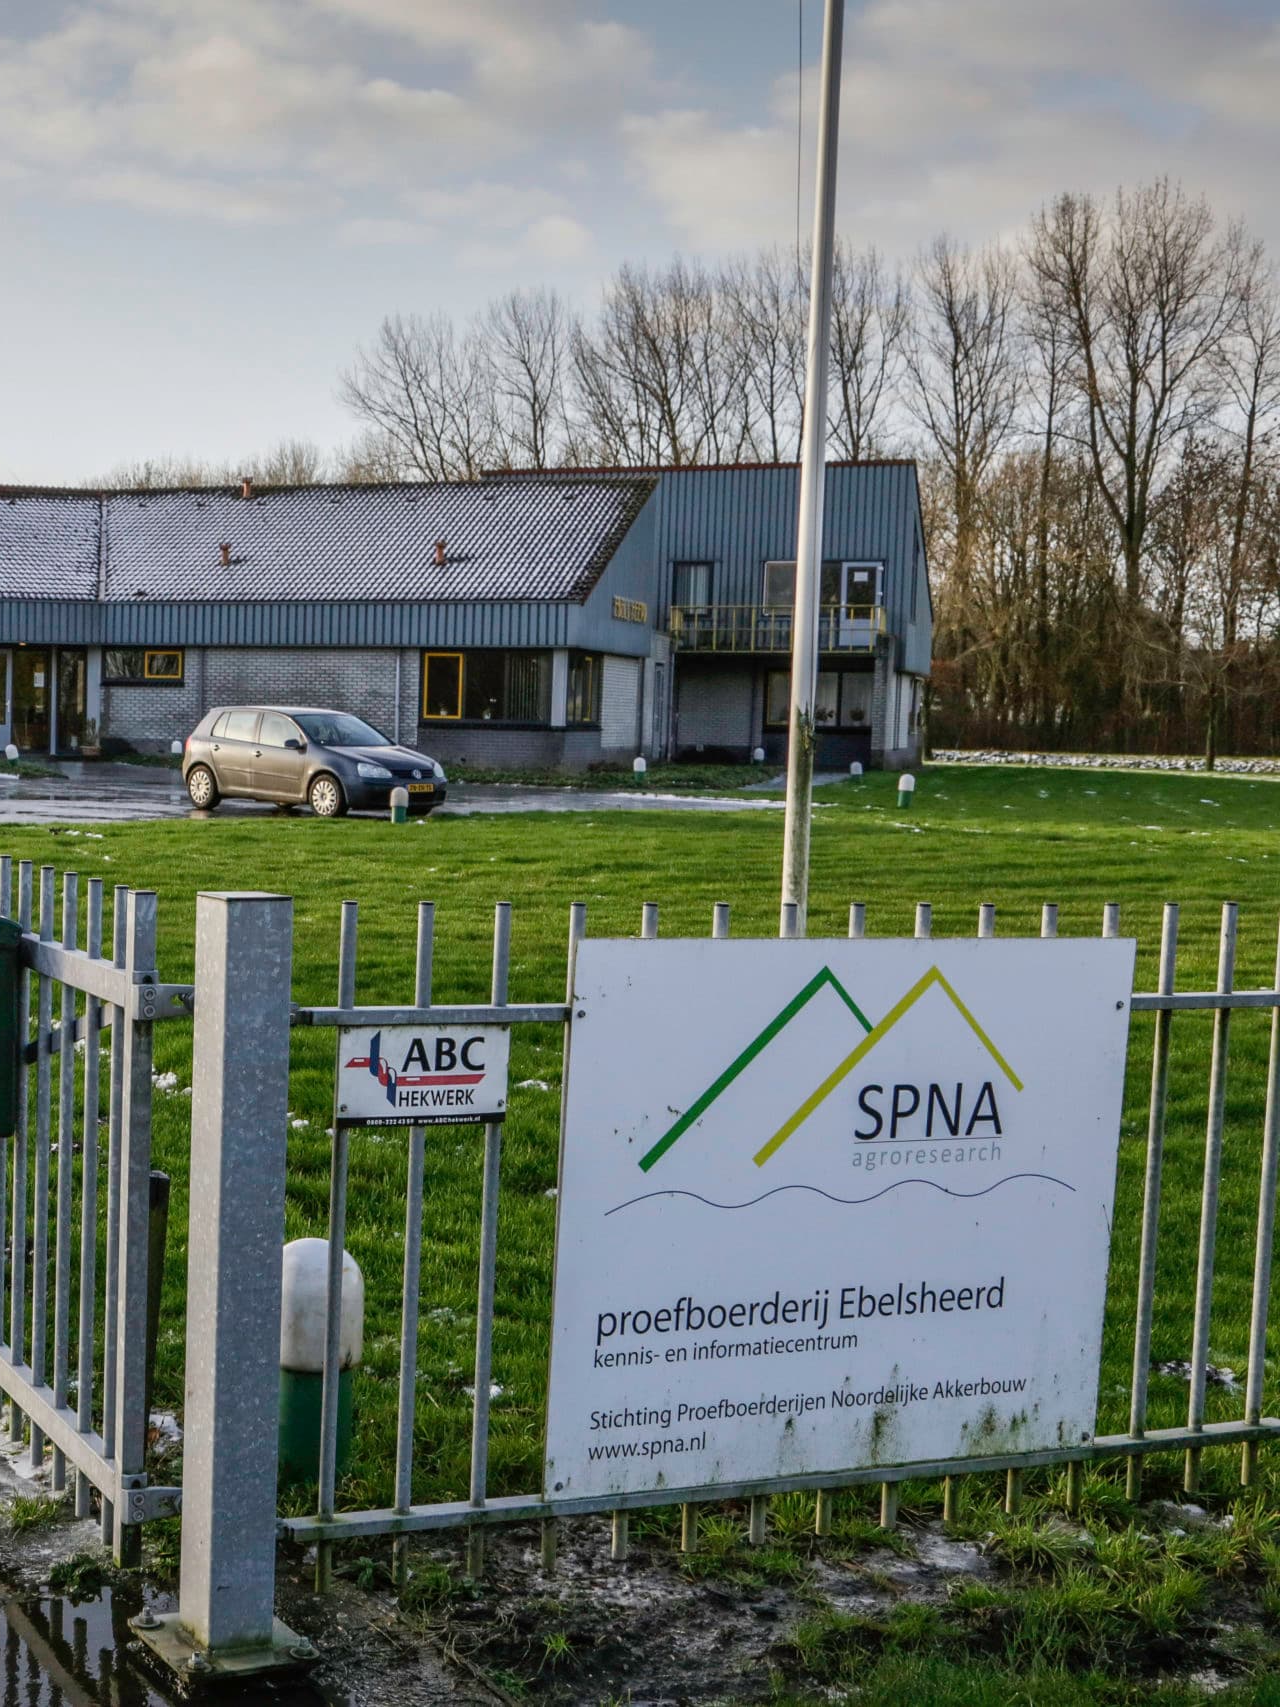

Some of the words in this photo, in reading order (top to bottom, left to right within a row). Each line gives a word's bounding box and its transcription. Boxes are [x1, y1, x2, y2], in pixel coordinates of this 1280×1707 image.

[401, 1036, 485, 1073] ABC
[399, 1089, 475, 1107] HEKWERK
[854, 1081, 1002, 1140] SPNA
[417, 1115, 481, 1124] www.ABChekwerk.nl
[852, 1142, 1001, 1171] agroresearch
[597, 1290, 829, 1346] proefboerderij
[839, 1276, 1005, 1319] Ebelsheerd
[594, 1347, 660, 1368] kennis-
[665, 1347, 687, 1362] en
[693, 1334, 858, 1361] informatiecentrum
[590, 1408, 671, 1430] Stichting
[677, 1394, 826, 1422] Proefboerderijen
[831, 1383, 928, 1408] Noordelijke
[933, 1377, 1027, 1399] Akkerbouw
[588, 1432, 706, 1460] www.spna.nl
